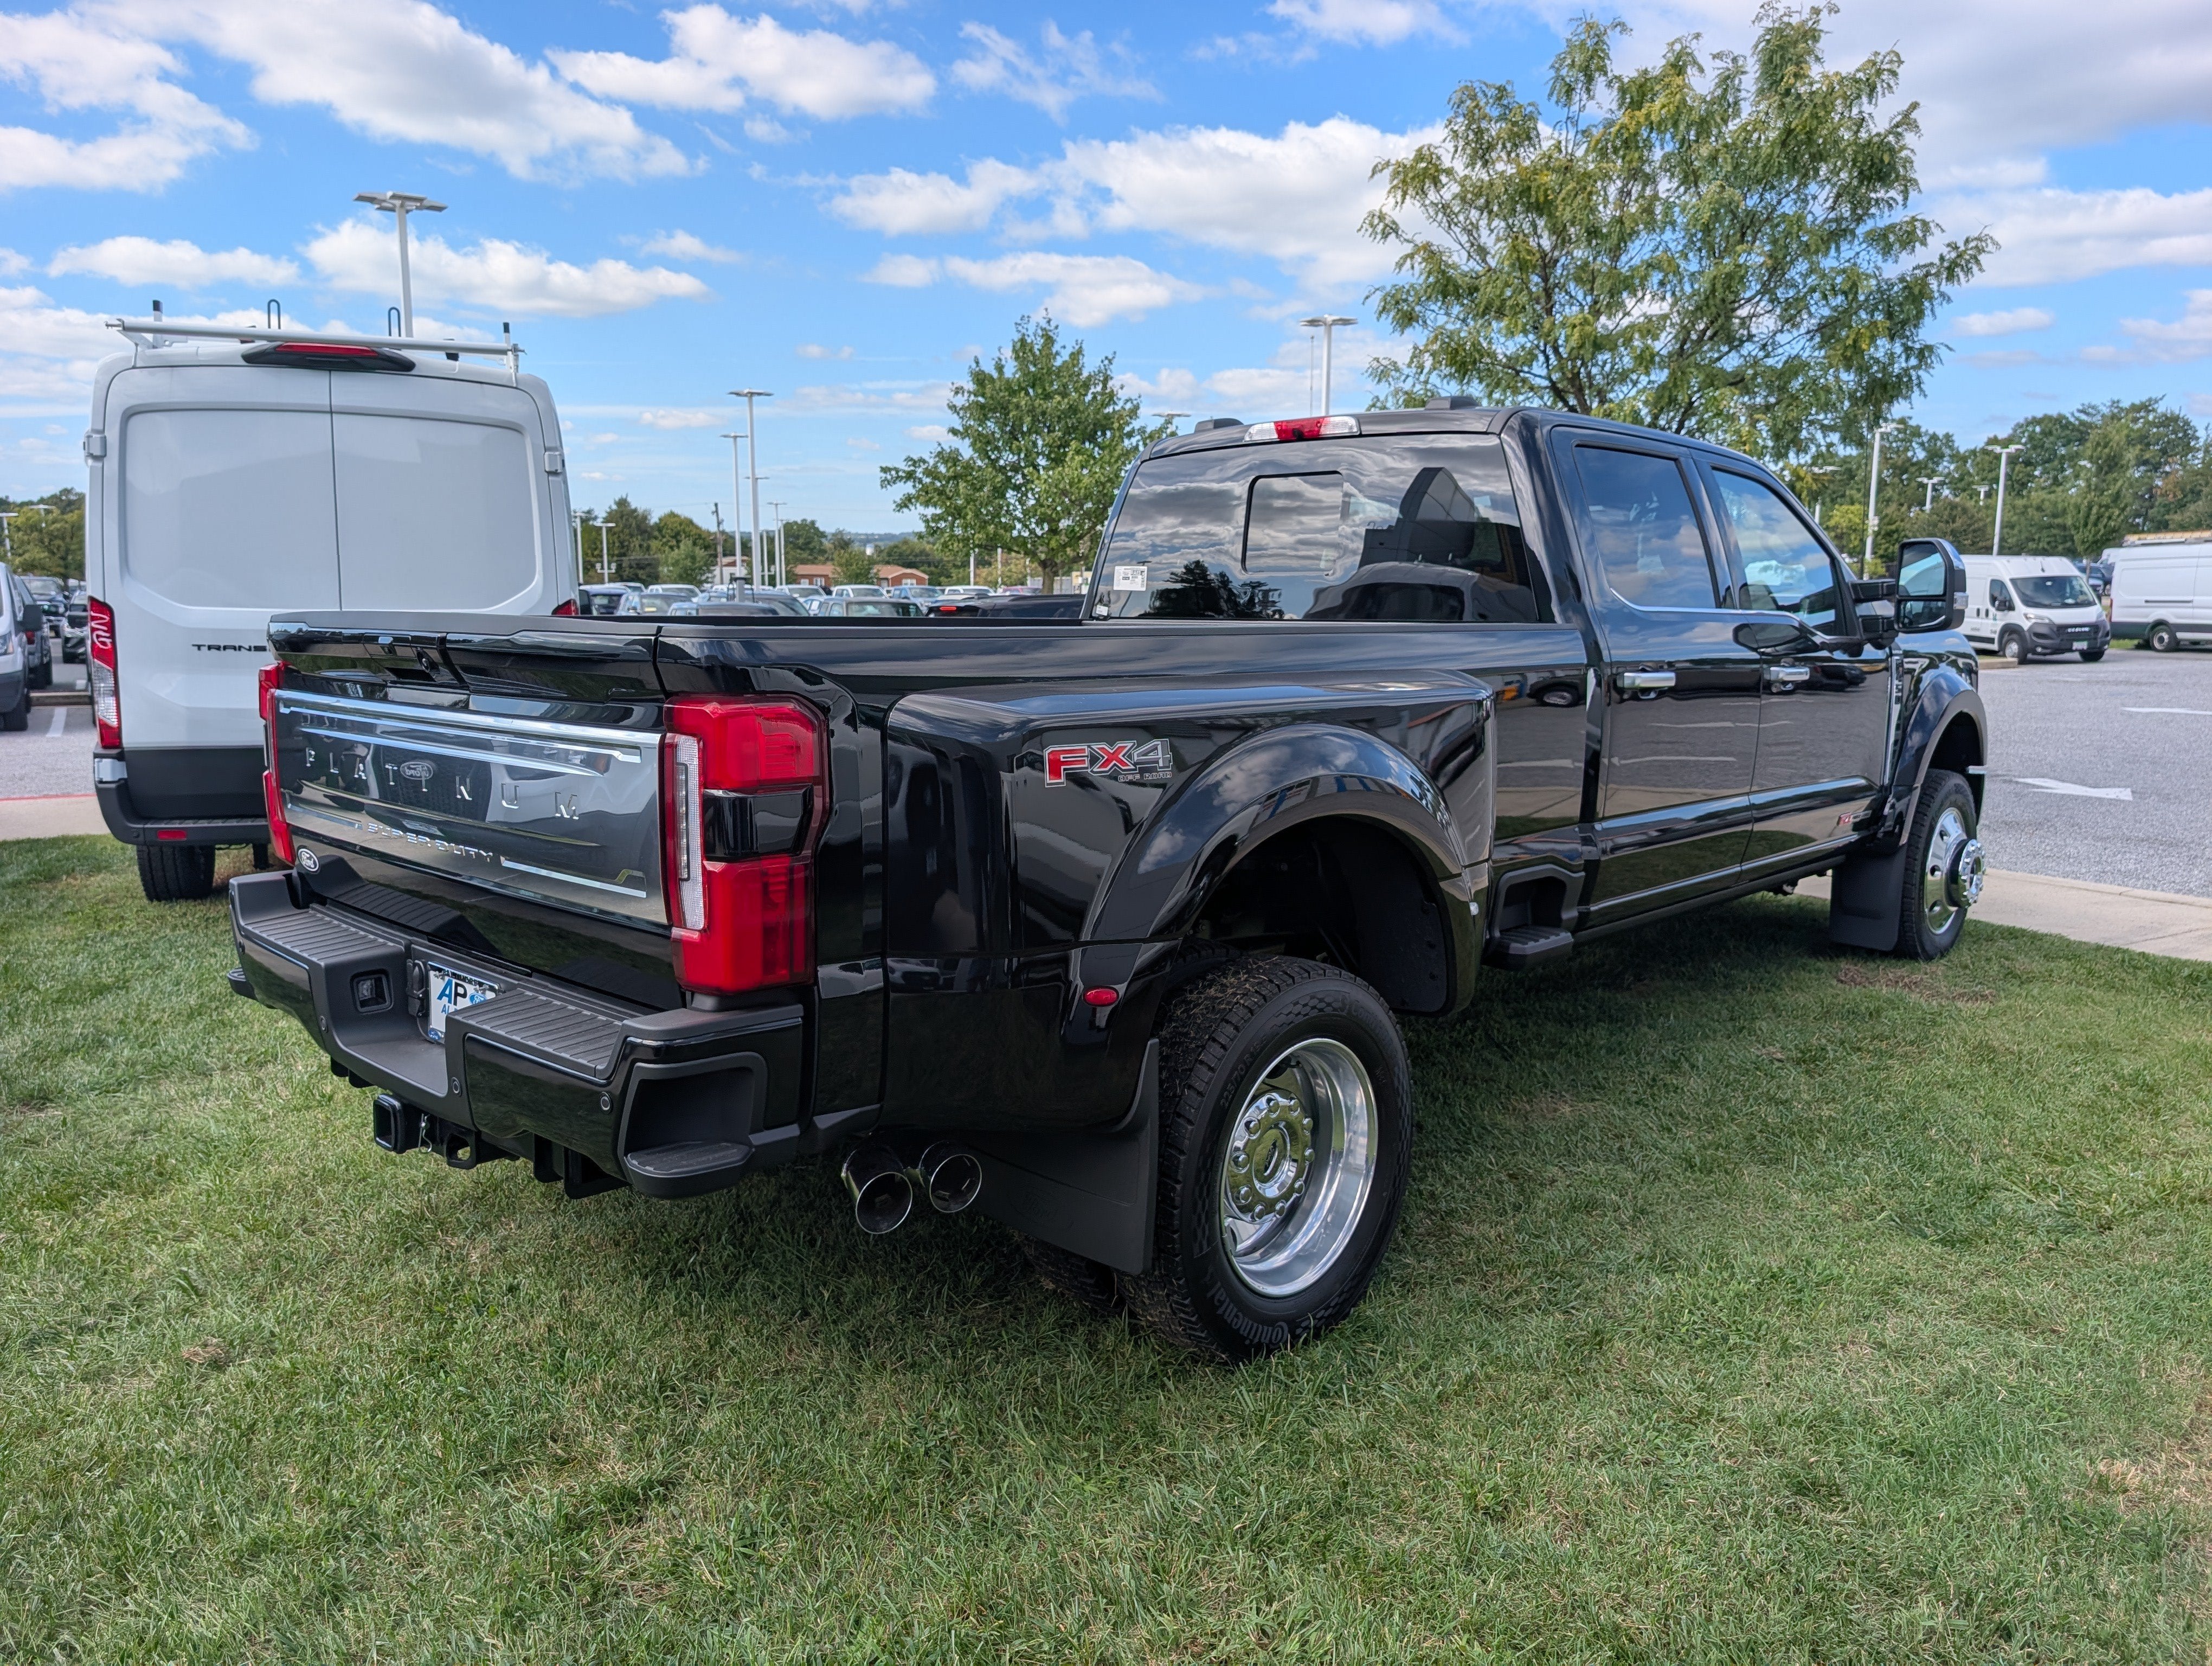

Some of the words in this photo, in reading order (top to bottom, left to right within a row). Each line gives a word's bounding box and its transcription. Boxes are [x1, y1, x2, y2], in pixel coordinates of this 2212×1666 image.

[191, 643, 268, 652] TRANS
[1044, 739, 1173, 788] FX4
[1118, 774, 1140, 782] OFF
[1143, 772, 1172, 780] ROAD
[368, 823, 431, 847] SUPER
[435, 839, 493, 862] DUTY
[301, 851, 316, 869] Ford
[437, 978, 467, 1006] AP
[1207, 1281, 1289, 1349] Continental
